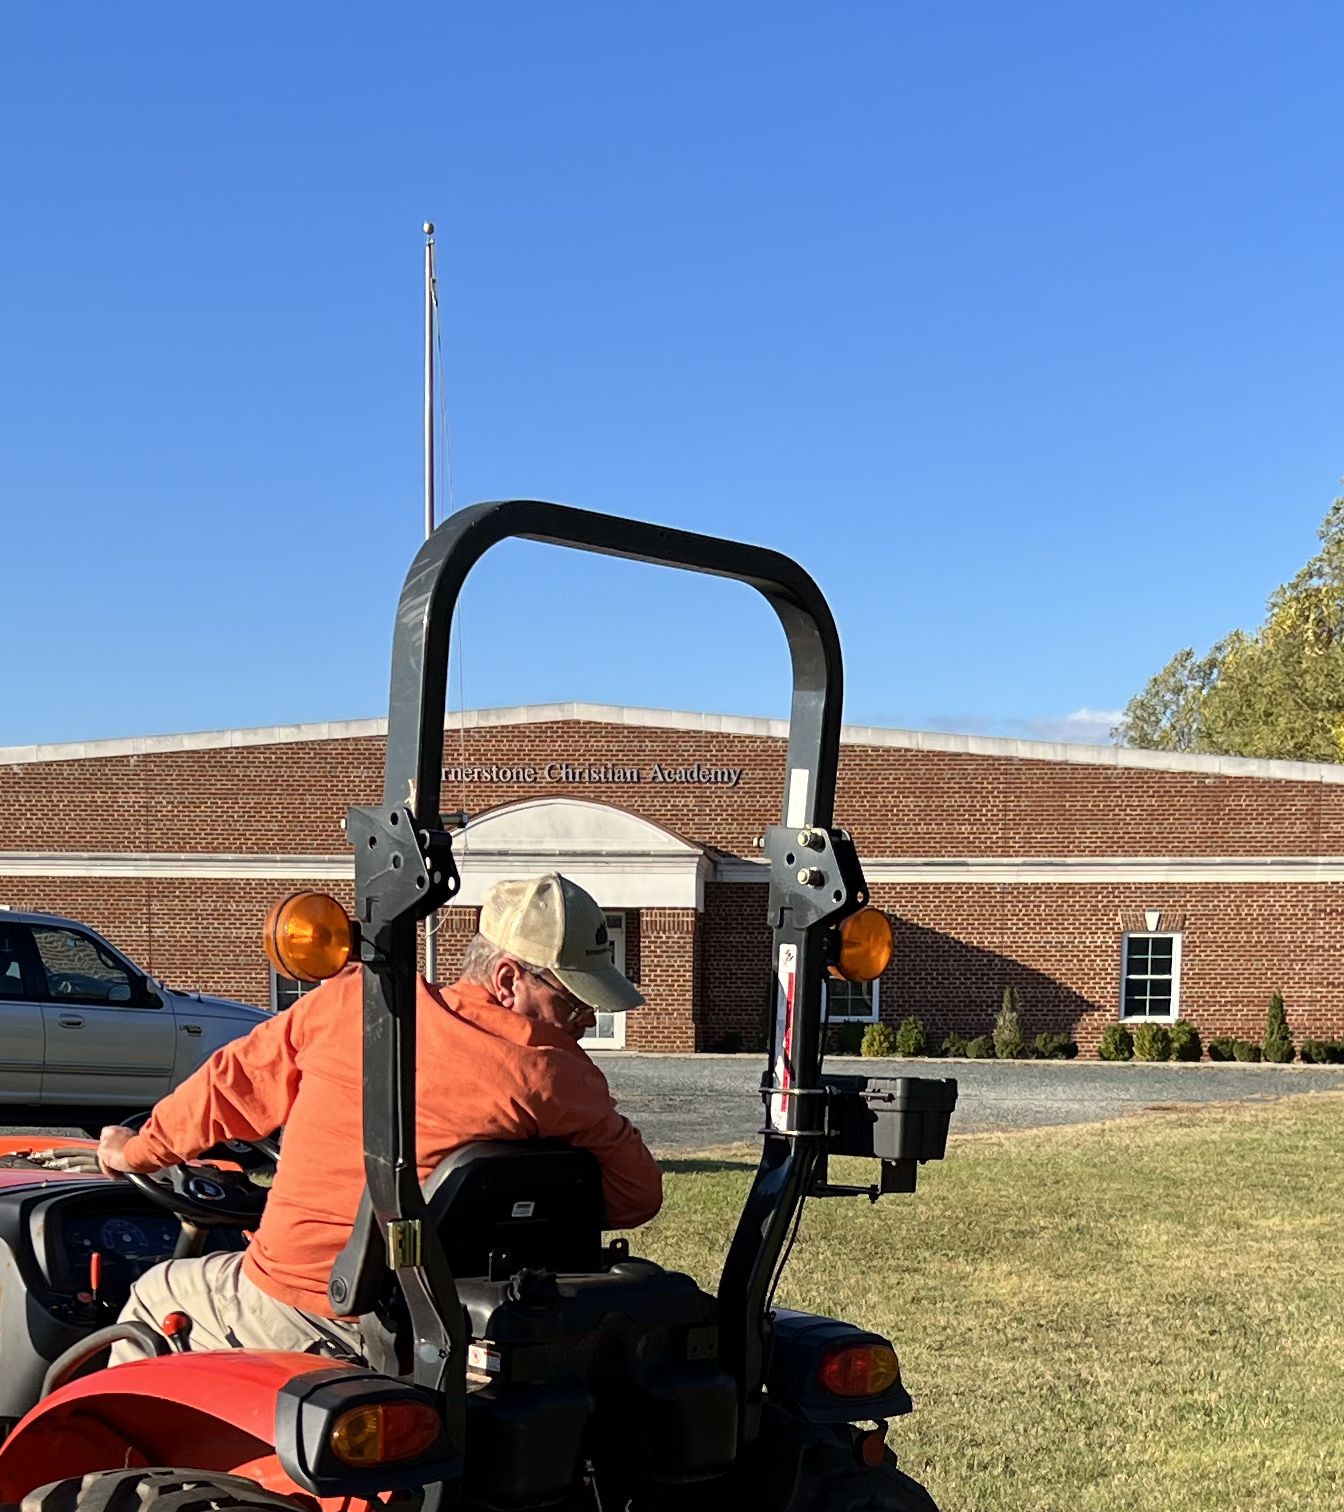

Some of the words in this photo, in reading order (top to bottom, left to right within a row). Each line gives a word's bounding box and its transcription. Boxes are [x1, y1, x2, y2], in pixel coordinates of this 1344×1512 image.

[441, 764, 538, 783] rnerstone
[544, 762, 641, 784] Christian
[650, 762, 743, 788] Academy
